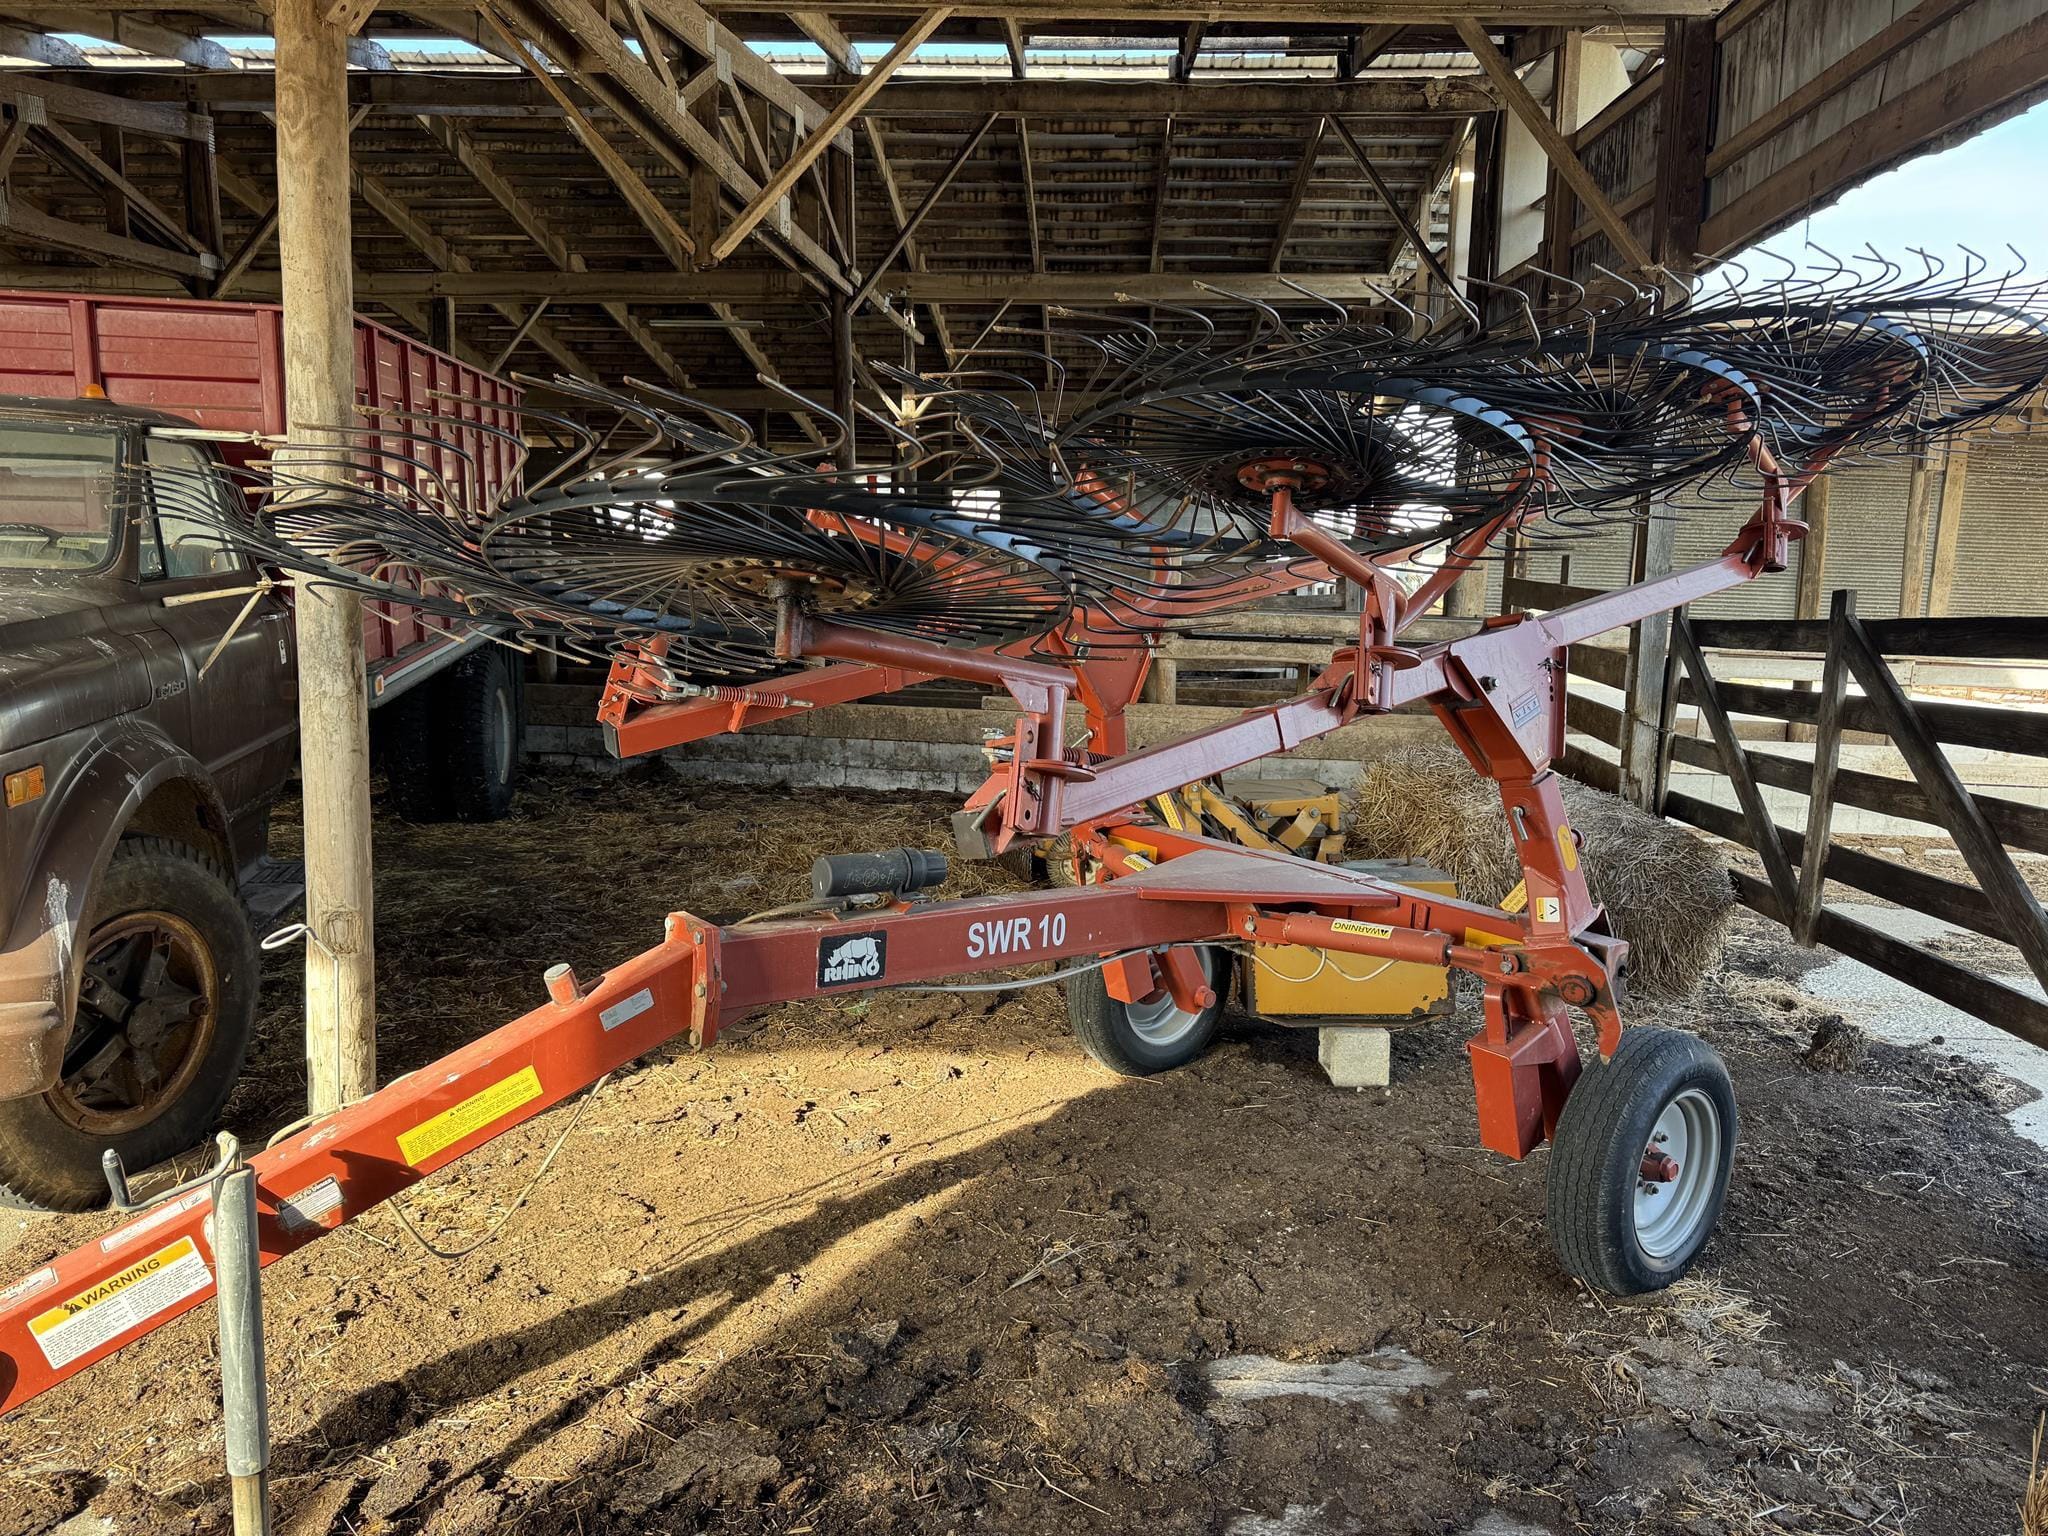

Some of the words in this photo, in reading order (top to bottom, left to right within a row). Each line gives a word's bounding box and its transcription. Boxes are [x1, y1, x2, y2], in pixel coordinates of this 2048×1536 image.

[967, 917, 1031, 958] SWR
[1039, 912, 1066, 948] 10
[1334, 922, 1380, 935] WARNING
[82, 1258, 160, 1305] WARNING
